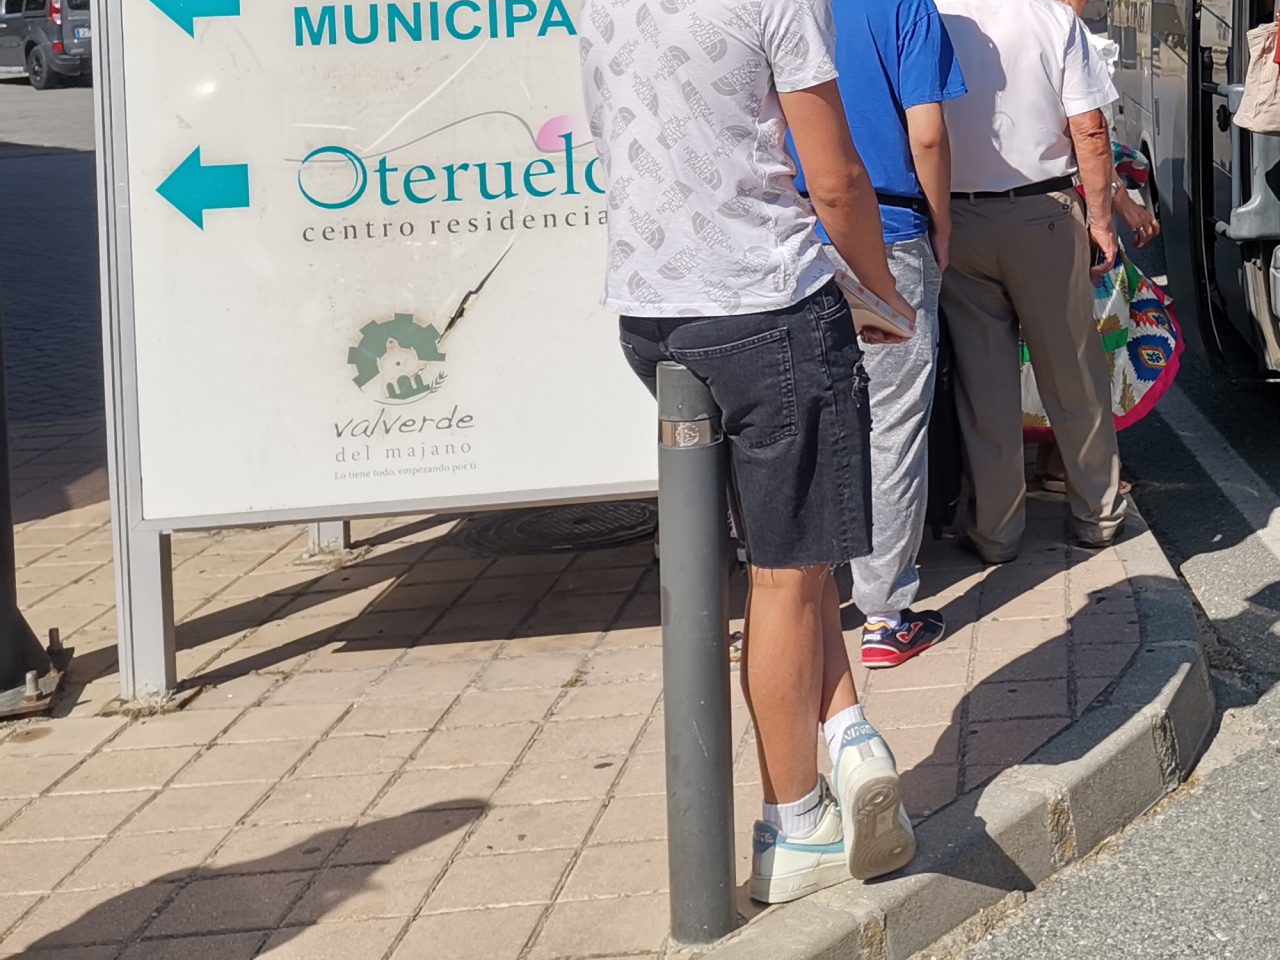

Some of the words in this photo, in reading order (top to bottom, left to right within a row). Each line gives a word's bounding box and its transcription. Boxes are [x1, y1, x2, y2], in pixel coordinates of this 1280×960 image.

[302, 220, 414, 242] centro
[334, 404, 476, 438] valverde
[335, 444, 370, 462] del
[385, 441, 472, 461] majano
[348, 471, 371, 480] tiene
[398, 464, 450, 476] empezando
[452, 464, 467, 473] por
